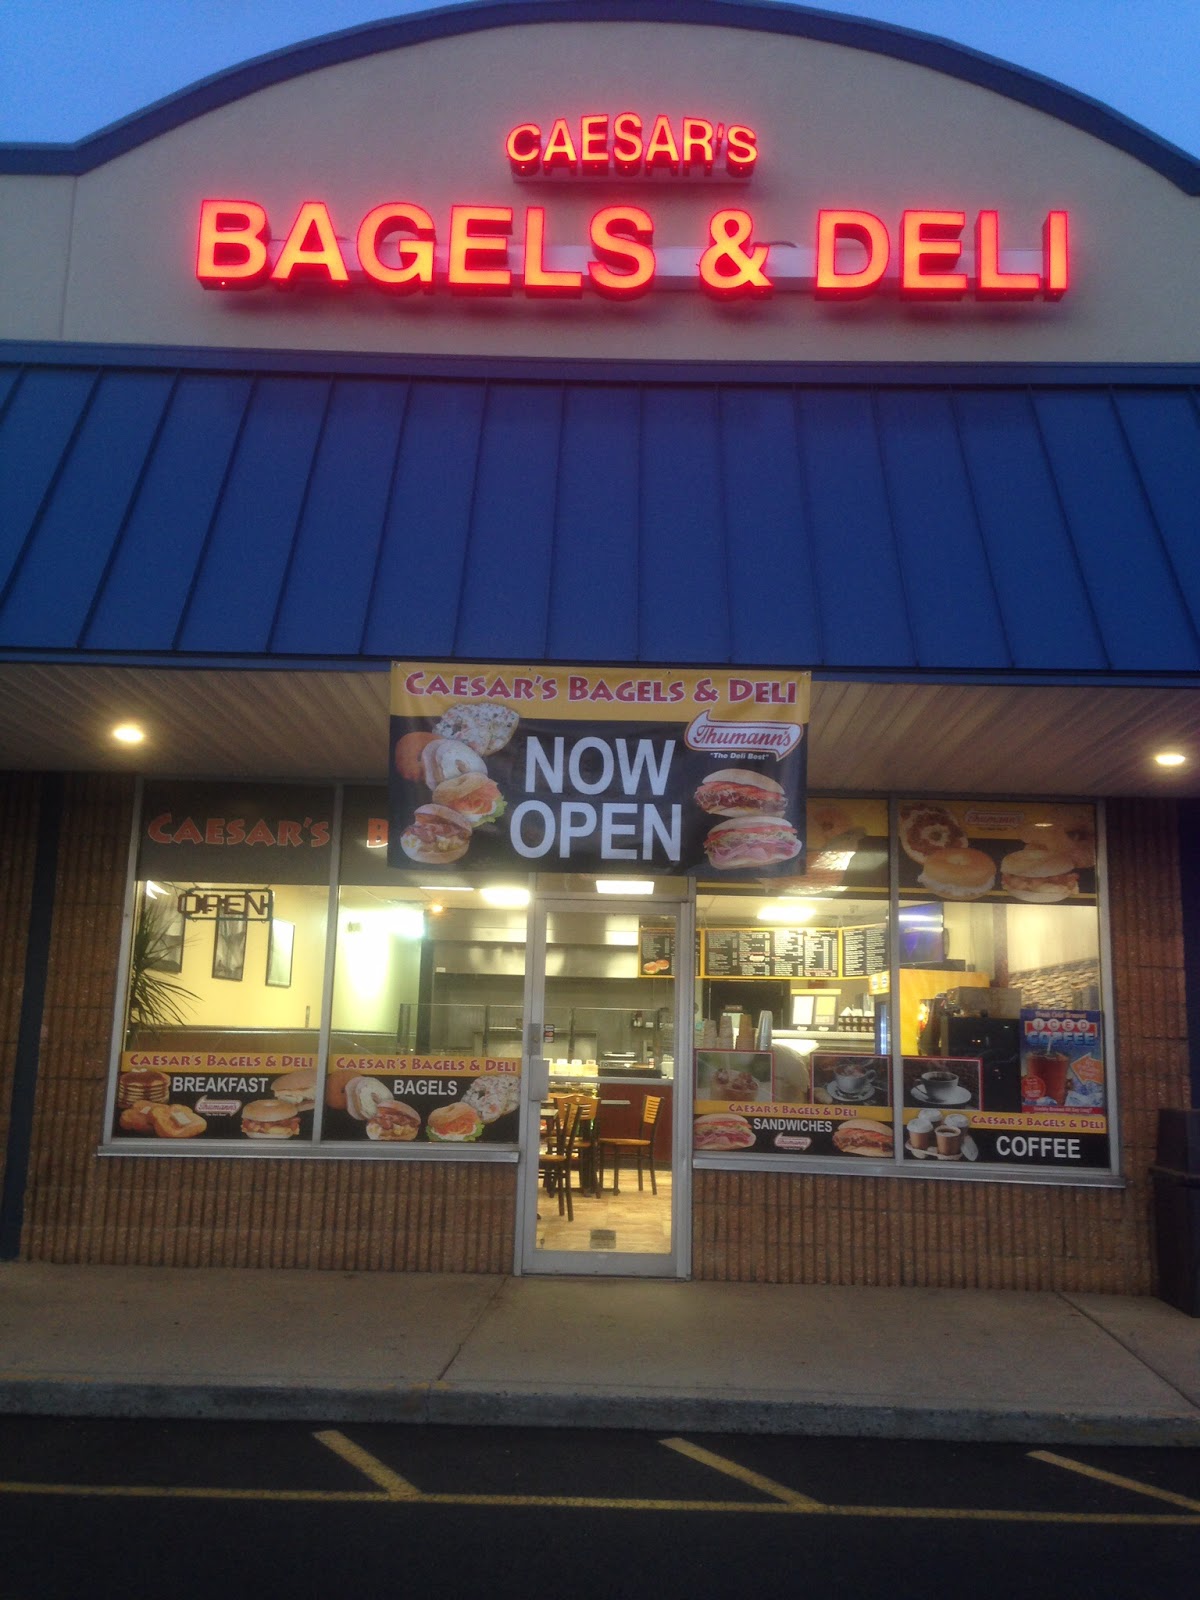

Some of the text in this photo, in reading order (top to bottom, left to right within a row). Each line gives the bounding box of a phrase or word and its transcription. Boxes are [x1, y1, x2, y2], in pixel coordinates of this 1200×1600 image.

[505, 111, 759, 168] CAESAR'S
[196, 199, 1069, 295] BAGELS & DELI
[404, 671, 797, 705] CAESAR'S BAGELS & DELI
[693, 723, 791, 747] Thumann's
[523, 735, 677, 796] NOW
[147, 812, 331, 848] CAESAR'S
[509, 800, 682, 862] OPEN
[177, 892, 270, 916] OPEN
[130, 1054, 314, 1068] CAESAR'S BAGELS & DELI
[336, 1056, 517, 1072] CAESAR'S BAGELS & DELI
[171, 1076, 269, 1093] BREAKFAST
[393, 1078, 458, 1097] BAGELS
[728, 1103, 858, 1117] CAESAR'S BAGELS & DELI
[753, 1117, 833, 1133] SANDWICHES
[1026, 1117, 1066, 1128] BAGELS
[1069, 1119, 1077, 1128] &
[1080, 1119, 1104, 1129] DELI
[995, 1135, 1082, 1159] COFFEE
